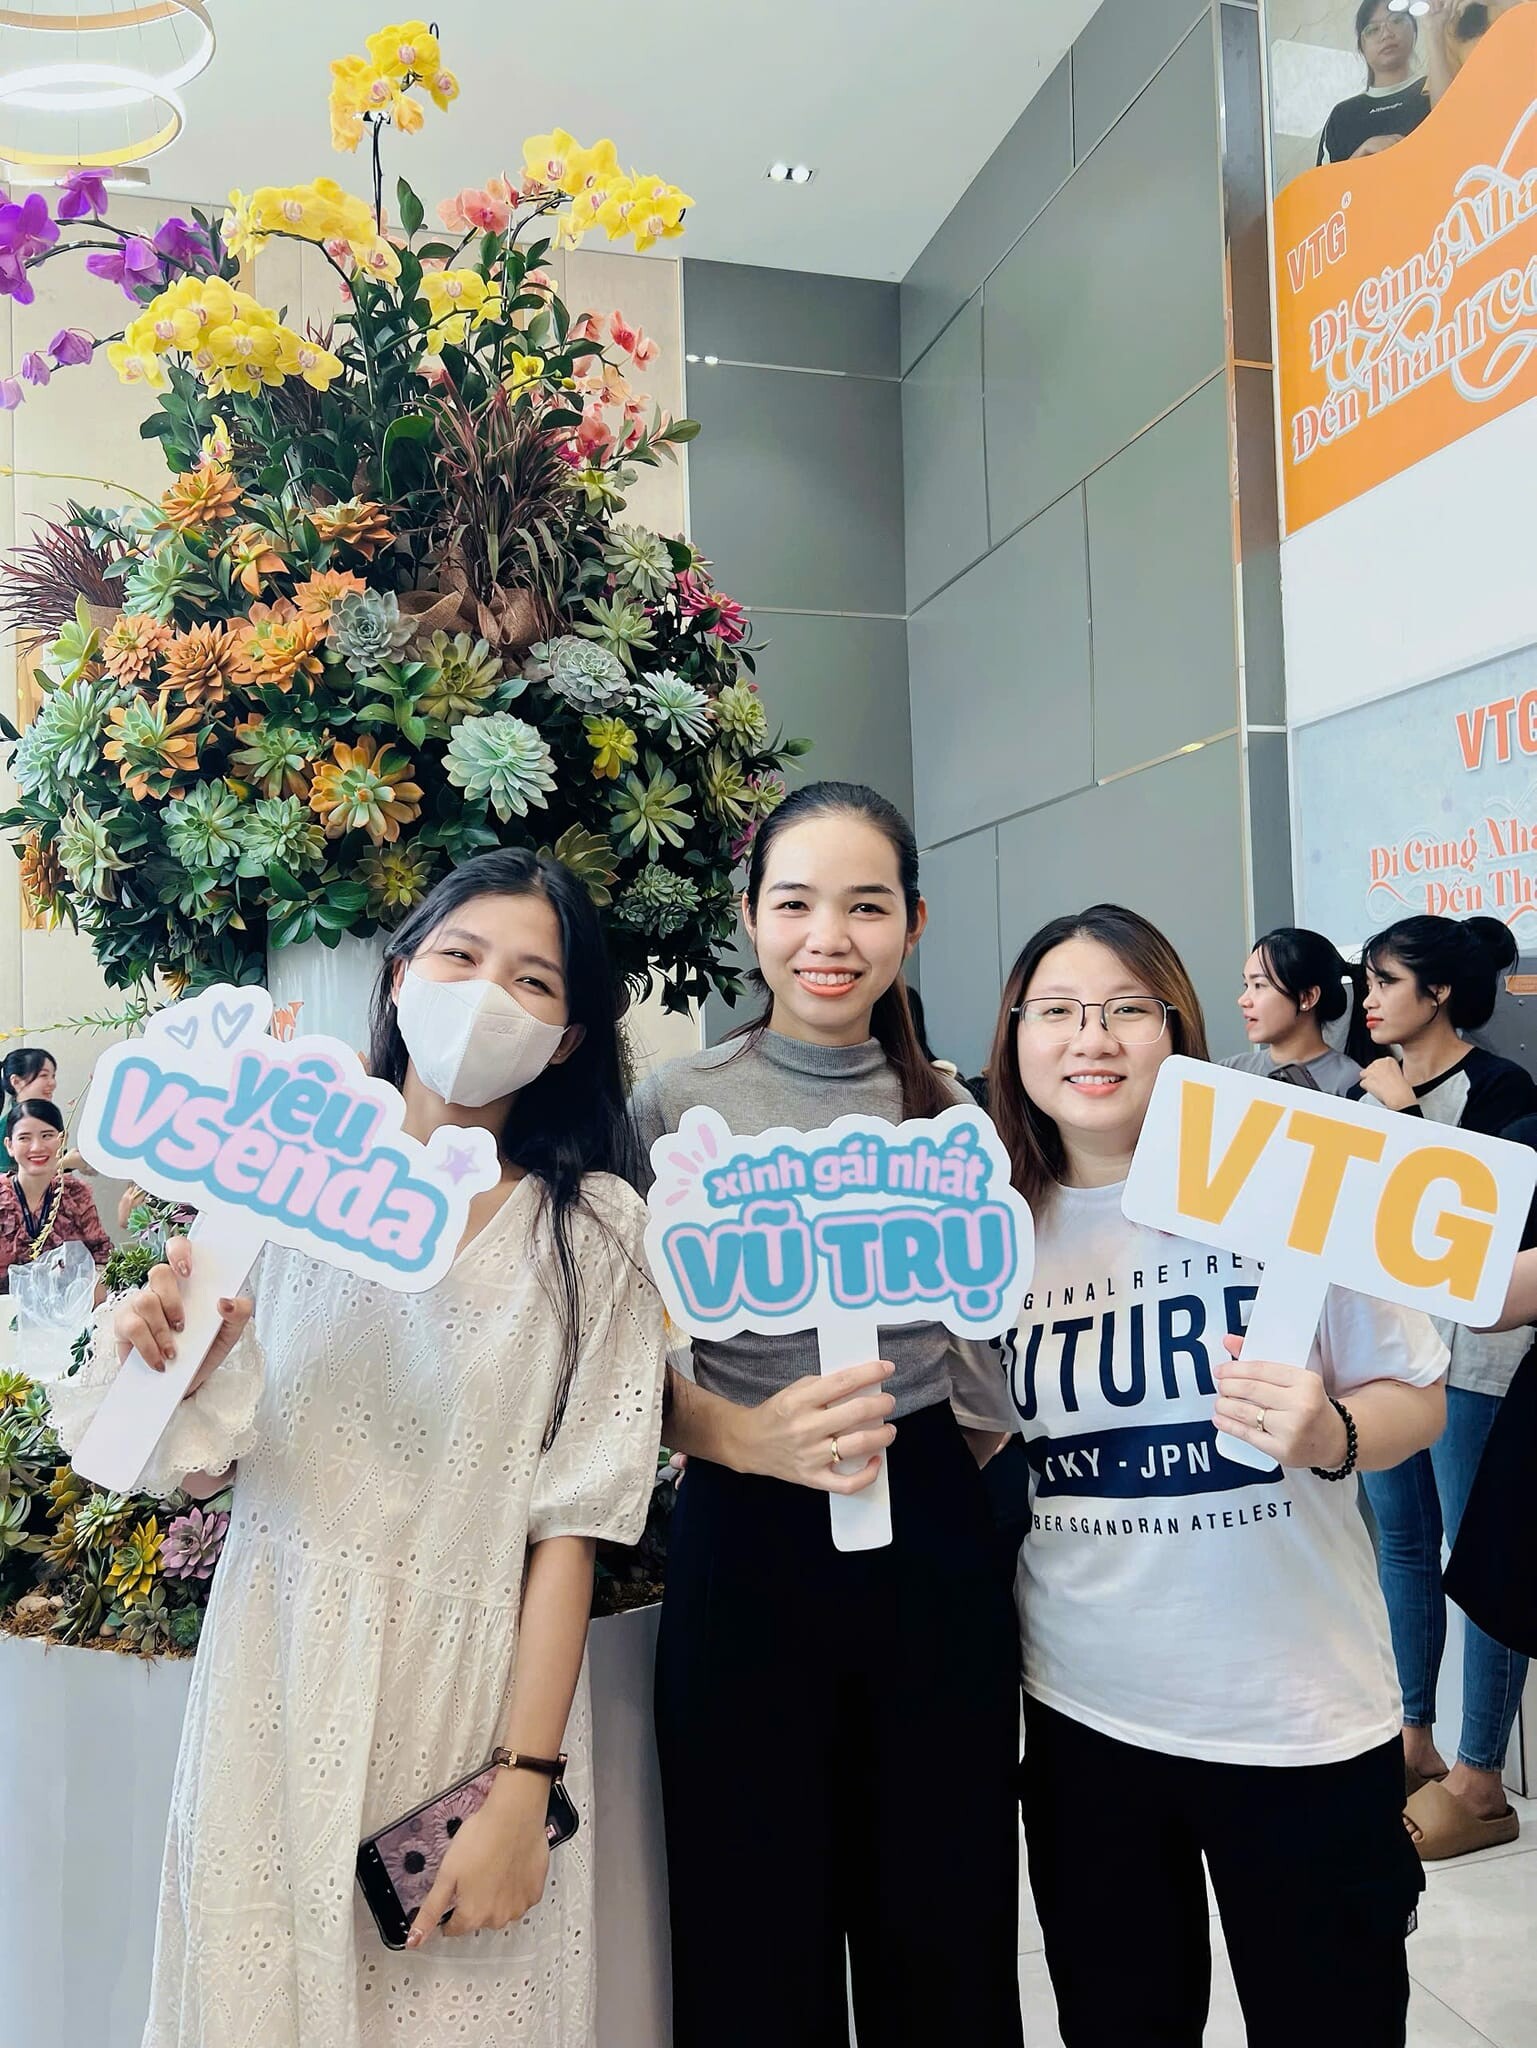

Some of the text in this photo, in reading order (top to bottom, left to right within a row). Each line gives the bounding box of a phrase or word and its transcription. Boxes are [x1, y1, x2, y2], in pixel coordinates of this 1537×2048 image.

[1293, 388, 1359, 464] Đến
[1370, 846, 1398, 881] Đi
[1404, 828, 1478, 873] Cùng
[1425, 868, 1537, 915] Đến Th
[224, 1053, 383, 1159] yêu
[711, 1130, 986, 1201] xinh gái nhất
[1176, 1080, 1499, 1302] VTG
[674, 1205, 1003, 1311] VŨ TRỤ
[1140, 1441, 1211, 1479] JPN
[1191, 1501, 1292, 1531] ATELEST
